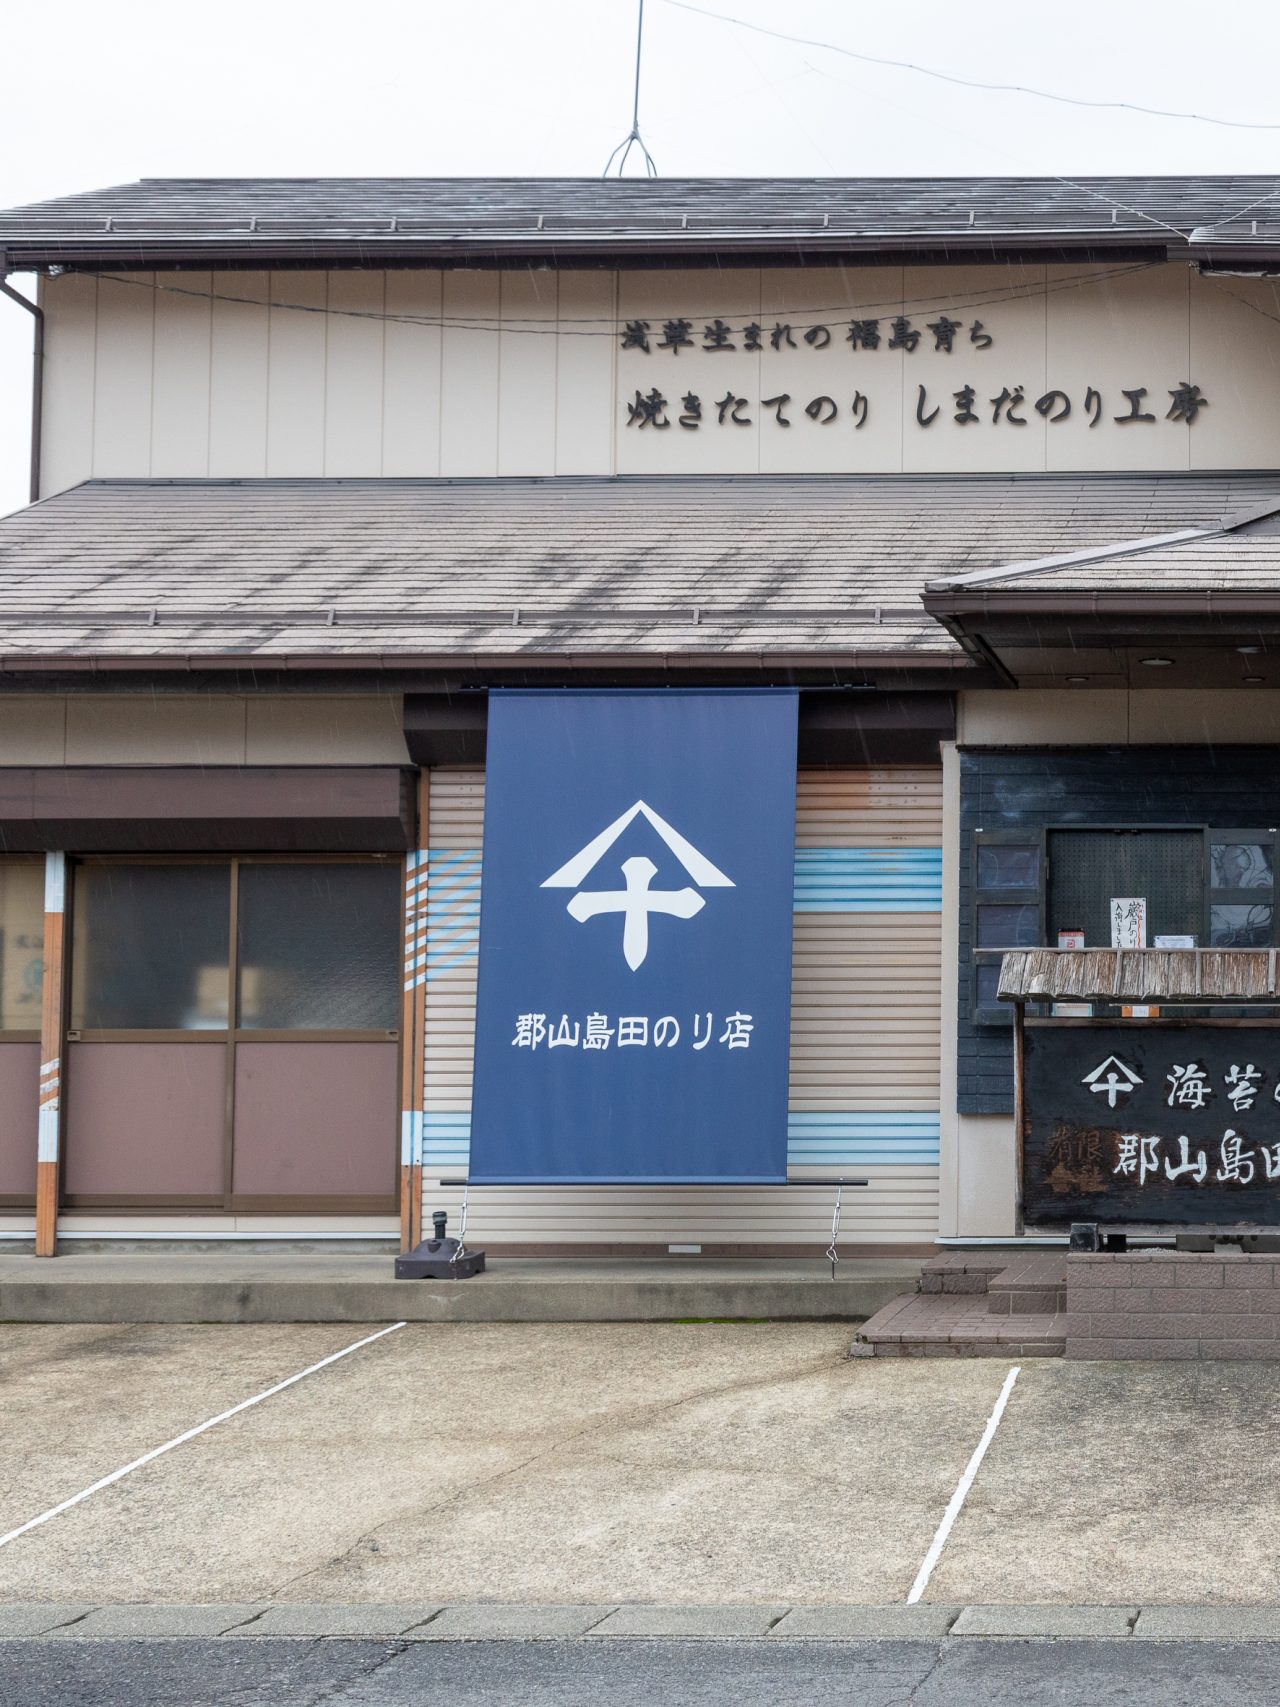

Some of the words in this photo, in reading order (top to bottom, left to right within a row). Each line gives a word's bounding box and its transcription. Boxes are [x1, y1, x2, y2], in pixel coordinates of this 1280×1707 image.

[626, 386, 869, 431] 焼きたてのり
[915, 382, 1209, 429] しまだのり工房
[511, 1010, 754, 1051] 郡山島田のり店
